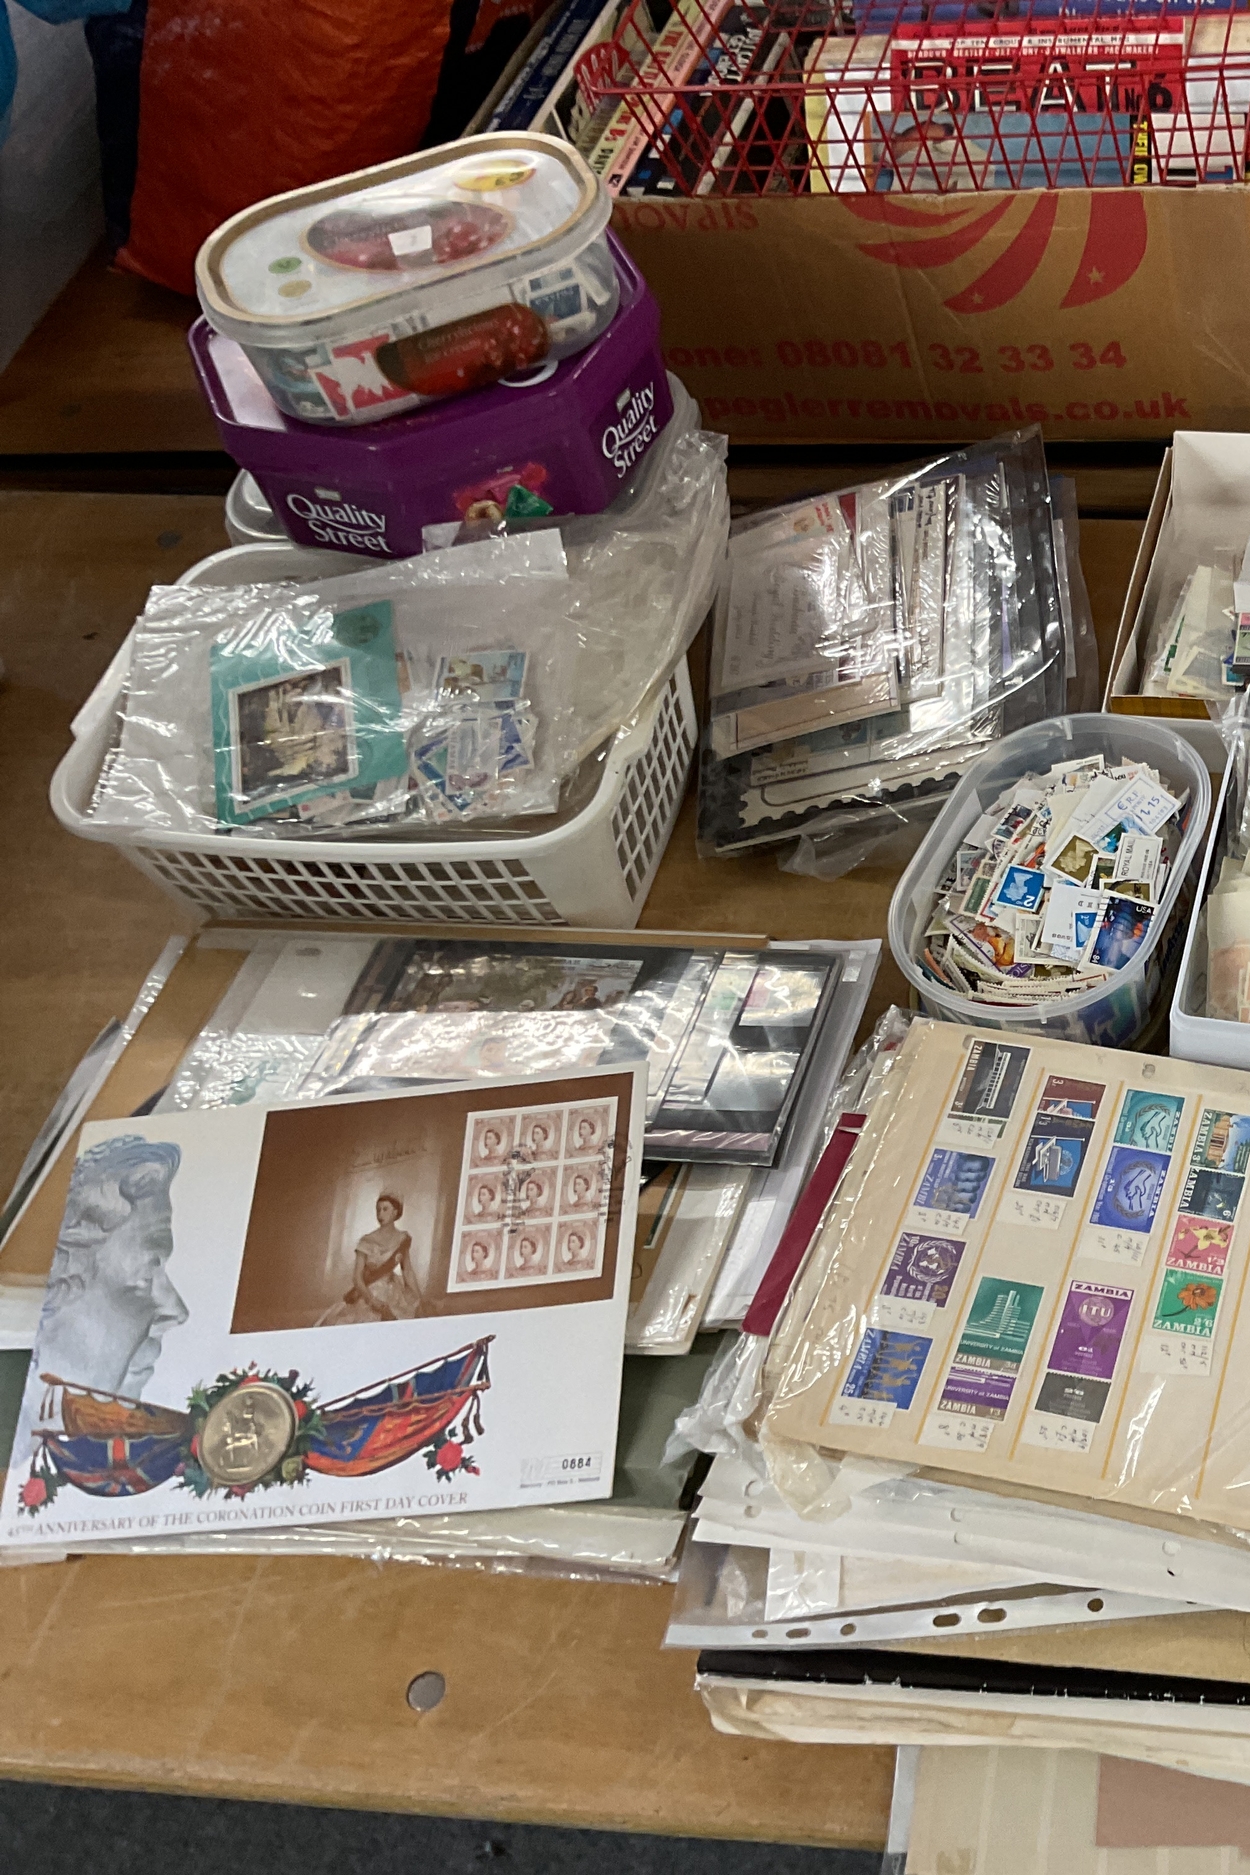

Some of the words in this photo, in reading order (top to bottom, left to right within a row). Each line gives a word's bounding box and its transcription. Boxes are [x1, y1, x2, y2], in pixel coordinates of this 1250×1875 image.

[905, 58, 1137, 112] BEAT
[775, 340, 912, 369] 08081
[929, 343, 984, 374] 32
[999, 344, 1055, 374] 33
[1069, 341, 1127, 370] 34
[603, 382, 655, 459] Quality
[615, 415, 658, 479] Street
[286, 494, 386, 533] Quality
[308, 521, 393, 554] Street
[1136, 905, 1151, 914] USA
[967, 1044, 983, 1072] ZAMBIA
[1198, 1111, 1212, 1154] ZAMBIA
[1179, 1167, 1200, 1209] ZAMBIA
[891, 1233, 908, 1271] ZAMBIA
[1166, 1256, 1223, 1275] ZAMBIA
[1073, 1282, 1130, 1299] ZAMBIA
[1081, 1304, 1111, 1318] ITU
[1153, 1319, 1211, 1338] ZAMBIA
[853, 1329, 875, 1371] ZAMBIA
[955, 1354, 991, 1368] ZAMBIA
[940, 1400, 977, 1415] ZAMBIA
[36, 1517, 135, 1537] ANNIVERSARY
[138, 1514, 157, 1528] OF
[163, 1512, 194, 1527] THE
[197, 1505, 297, 1525] CORONATION
[299, 1502, 336, 1517] COIN
[340, 1499, 382, 1514] FIRST
[385, 1496, 416, 1511] DAY
[418, 1492, 468, 1507] COVER
